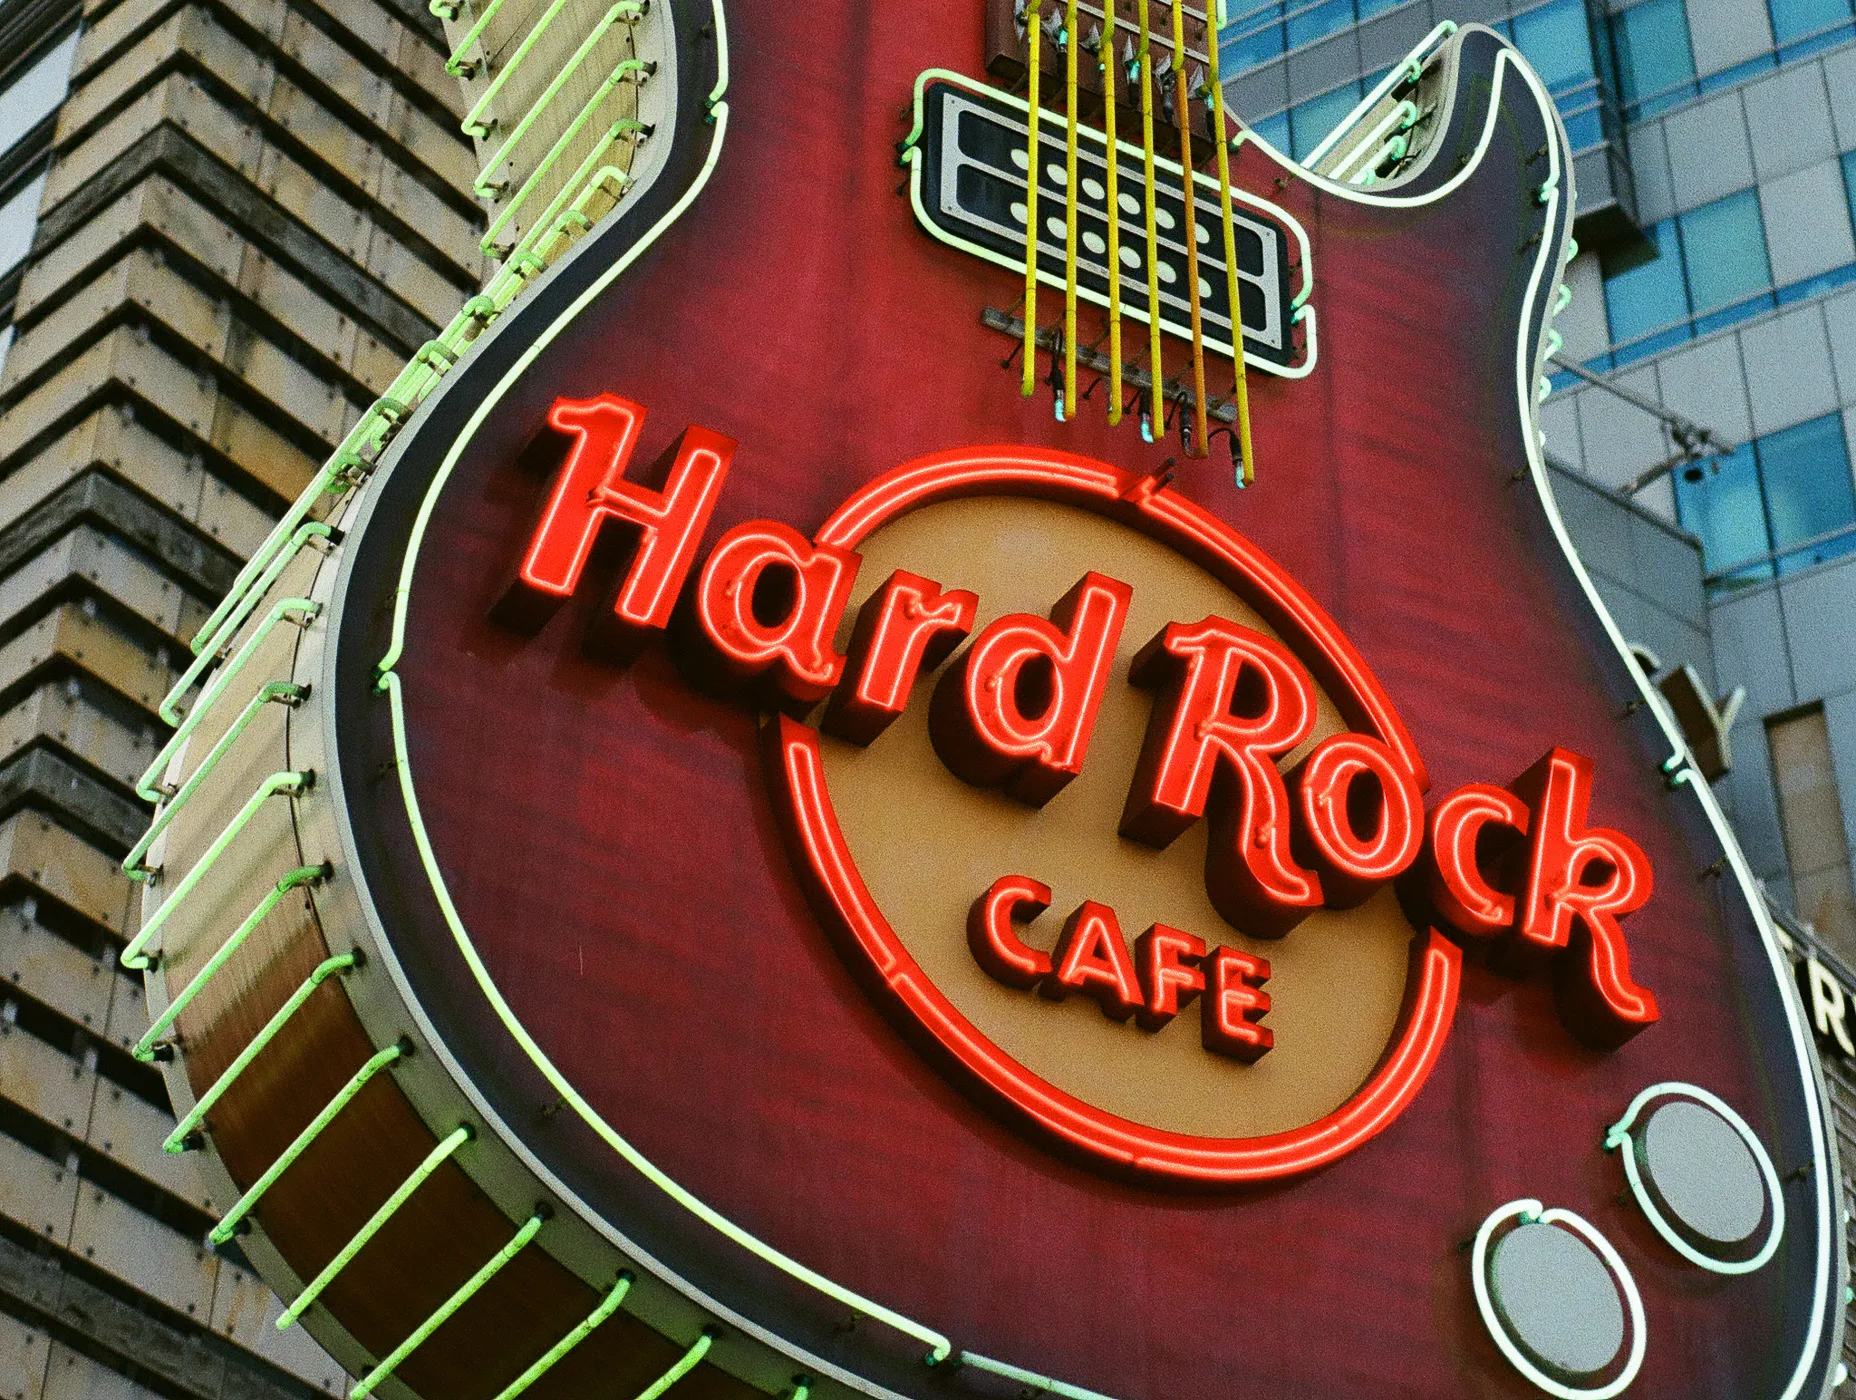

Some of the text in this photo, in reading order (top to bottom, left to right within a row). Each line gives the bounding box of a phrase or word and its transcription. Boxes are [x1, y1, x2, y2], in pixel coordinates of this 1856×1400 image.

[517, 391, 1660, 1024] Hard Rock
[979, 874, 1274, 1056] CAFE
